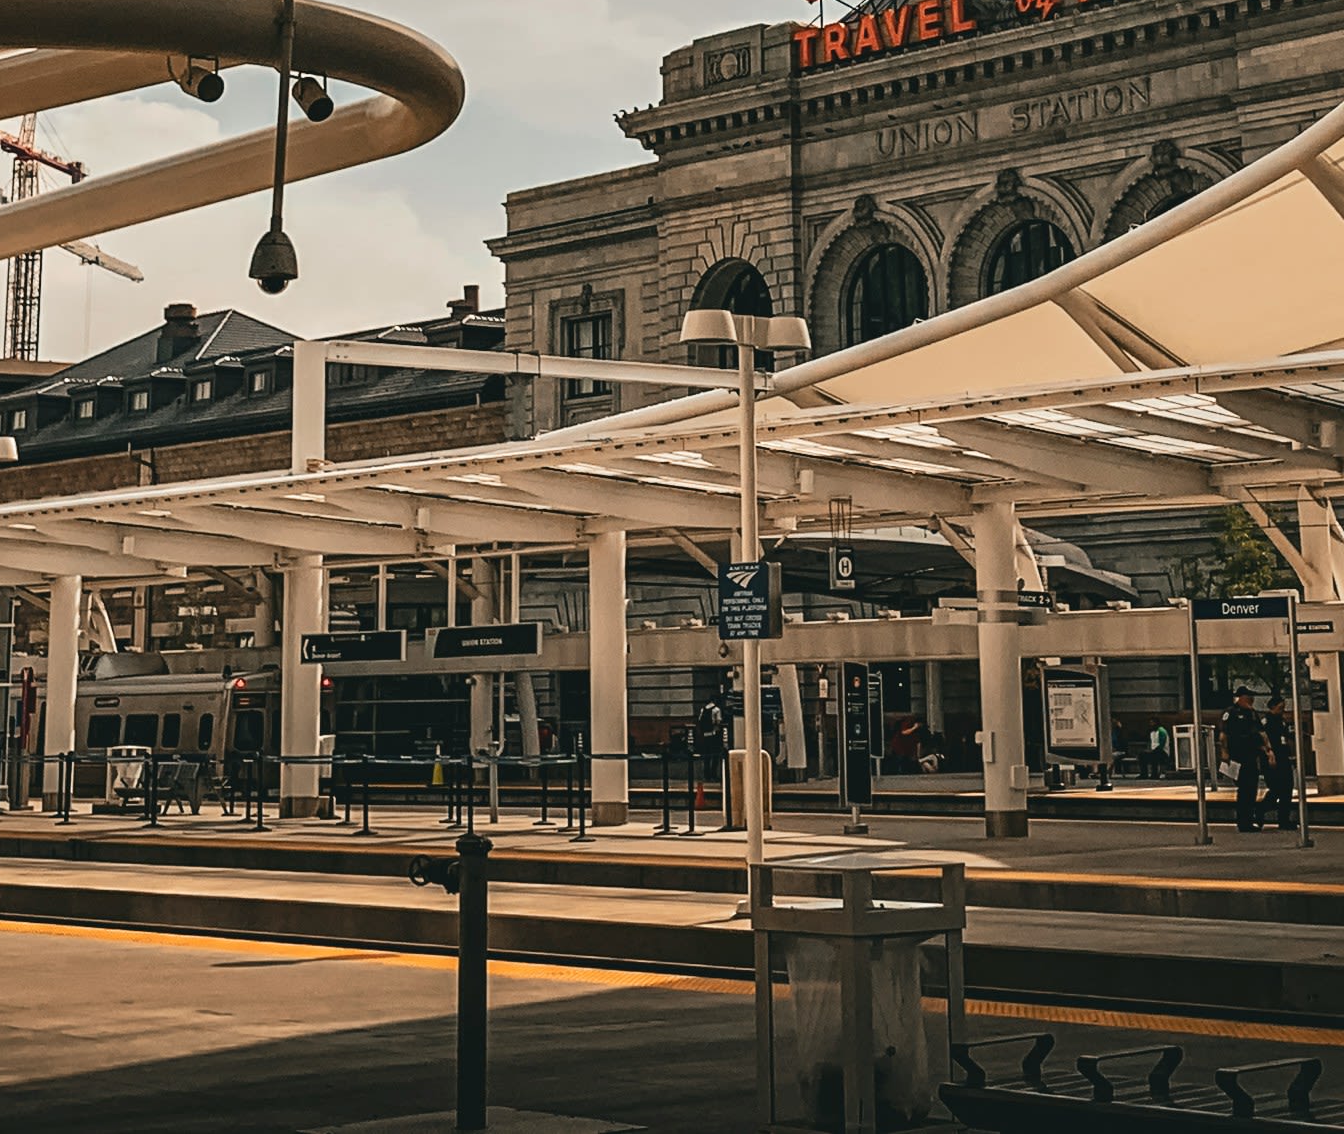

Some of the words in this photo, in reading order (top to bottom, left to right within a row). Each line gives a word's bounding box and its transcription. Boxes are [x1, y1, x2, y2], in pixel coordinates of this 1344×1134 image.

[875, 111, 980, 158] UNION
[1010, 75, 1152, 134] STATION
[1039, 595, 1045, 605] 2
[1222, 602, 1259, 616] Denver
